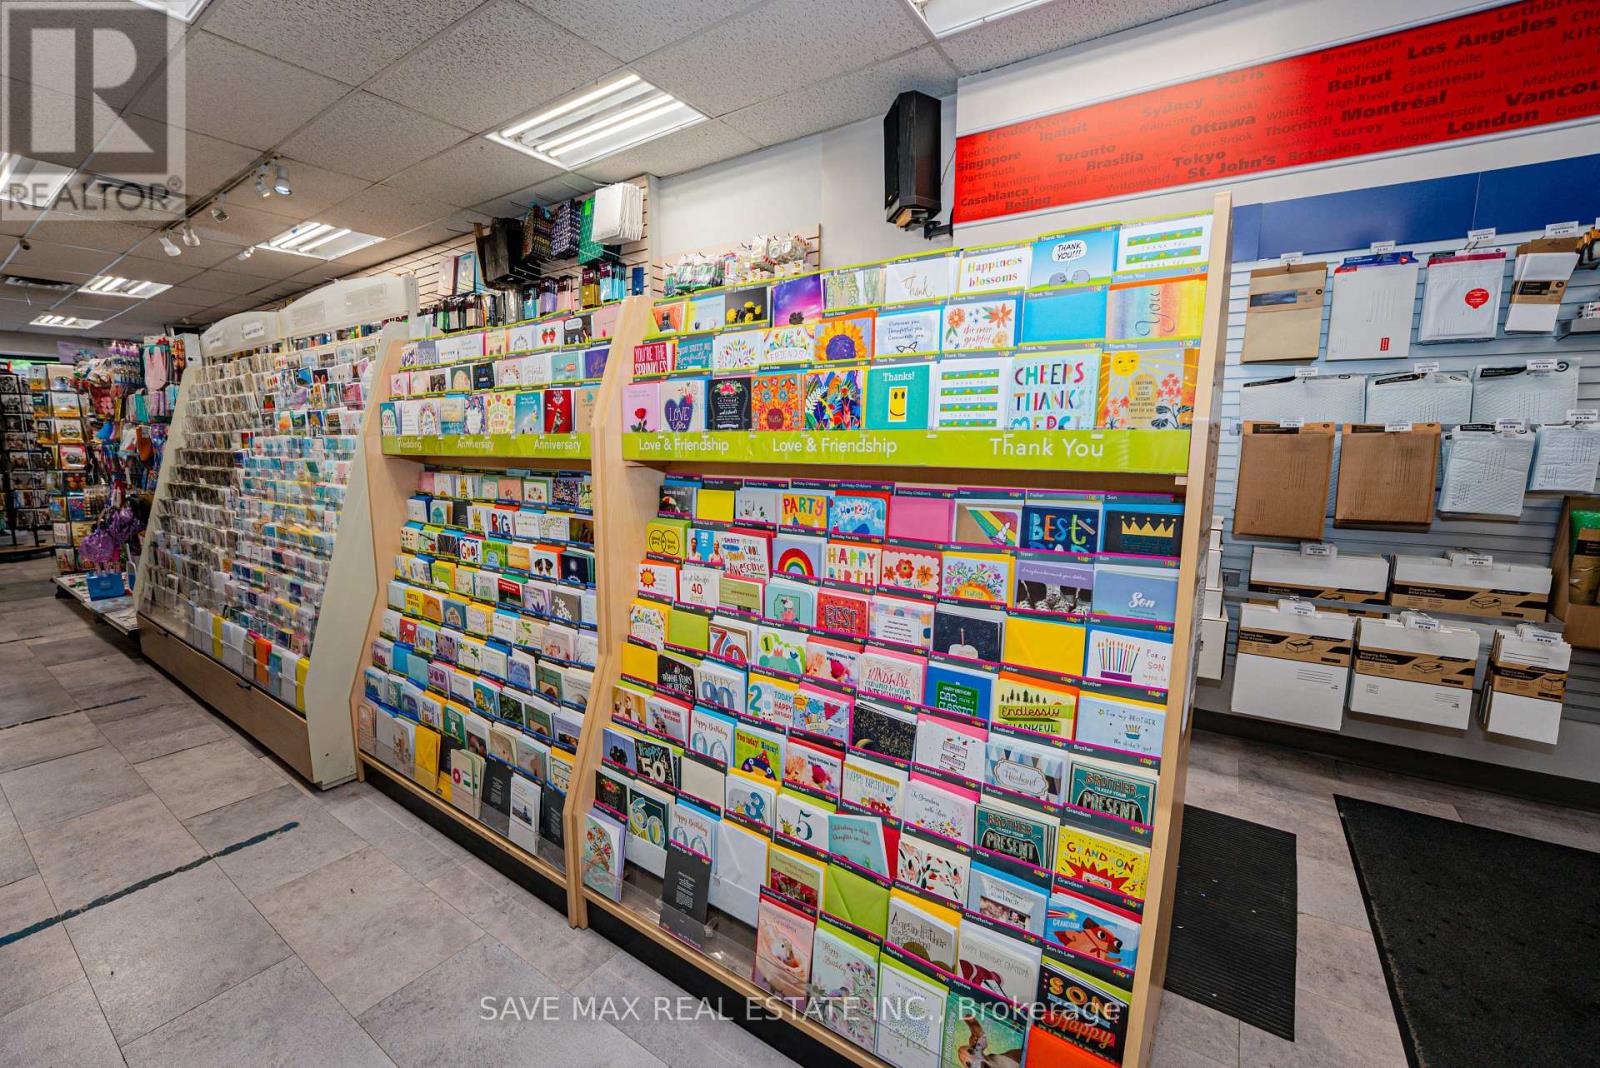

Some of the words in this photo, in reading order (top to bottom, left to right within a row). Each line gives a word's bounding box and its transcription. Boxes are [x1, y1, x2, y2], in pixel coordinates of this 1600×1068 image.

[1407, 41, 1447, 60] Los
[1455, 16, 1558, 49] Angeles
[1320, 38, 1403, 65] Brampton
[1328, 69, 1393, 93] Beirut
[1402, 70, 1486, 94] Gatineau
[1522, 65, 1597, 88] Medicine
[1341, 89, 1448, 123] Montréal
[1190, 114, 1257, 137] Ottawa
[1332, 122, 1384, 139] Surrey
[1447, 109, 1540, 135] London
[958, 151, 1022, 172] Singapore
[1056, 143, 1116, 163] Toronto
[1173, 150, 1226, 168] Tokyo
[1187, 166, 1211, 180] St.
[1217, 155, 1277, 175] John's
[960, 187, 1030, 207] Casablanca
[1004, 196, 1052, 211] Beijing
[1057, 242, 1081, 252] THANK
[1057, 250, 1082, 260] YOU!!!
[967, 257, 1022, 273] Happiness
[968, 272, 1018, 287] blossoms
[883, 371, 915, 382] Thanks!
[1014, 361, 1085, 386] CHEERS
[1013, 388, 1086, 411] THANKS
[669, 407, 690, 421] LOVE
[457, 439, 495, 451] Anniversary
[534, 439, 582, 452] Anniversary
[638, 439, 661, 451] Love
[663, 440, 672, 451] &
[674, 438, 729, 455] Friendship
[772, 438, 802, 453] Love
[806, 438, 817, 453] &
[821, 437, 898, 455] Friendship
[989, 437, 1053, 456] Thank
[1062, 438, 1105, 457] You
[783, 497, 824, 517] PARTY
[827, 547, 876, 569] HAPPY
[691, 583, 703, 594] 40
[1128, 592, 1156, 609] Son
[824, 604, 858, 629] BEST
[709, 625, 748, 665] 70
[749, 684, 763, 712] 2
[774, 690, 792, 702] TODAY
[774, 701, 793, 712] HAPPY
[1000, 706, 1061, 718] Endlessly
[1073, 744, 1094, 752] Brother
[640, 756, 666, 783] 50
[1085, 772, 1137, 795] BROTHER
[1065, 806, 1092, 819] Grandson
[1082, 792, 1138, 820] PRESENT
[796, 809, 813, 841] 5
[987, 814, 1033, 835] BROTHER
[976, 850, 989, 858] Uncle
[985, 831, 1035, 860] PRESENT
